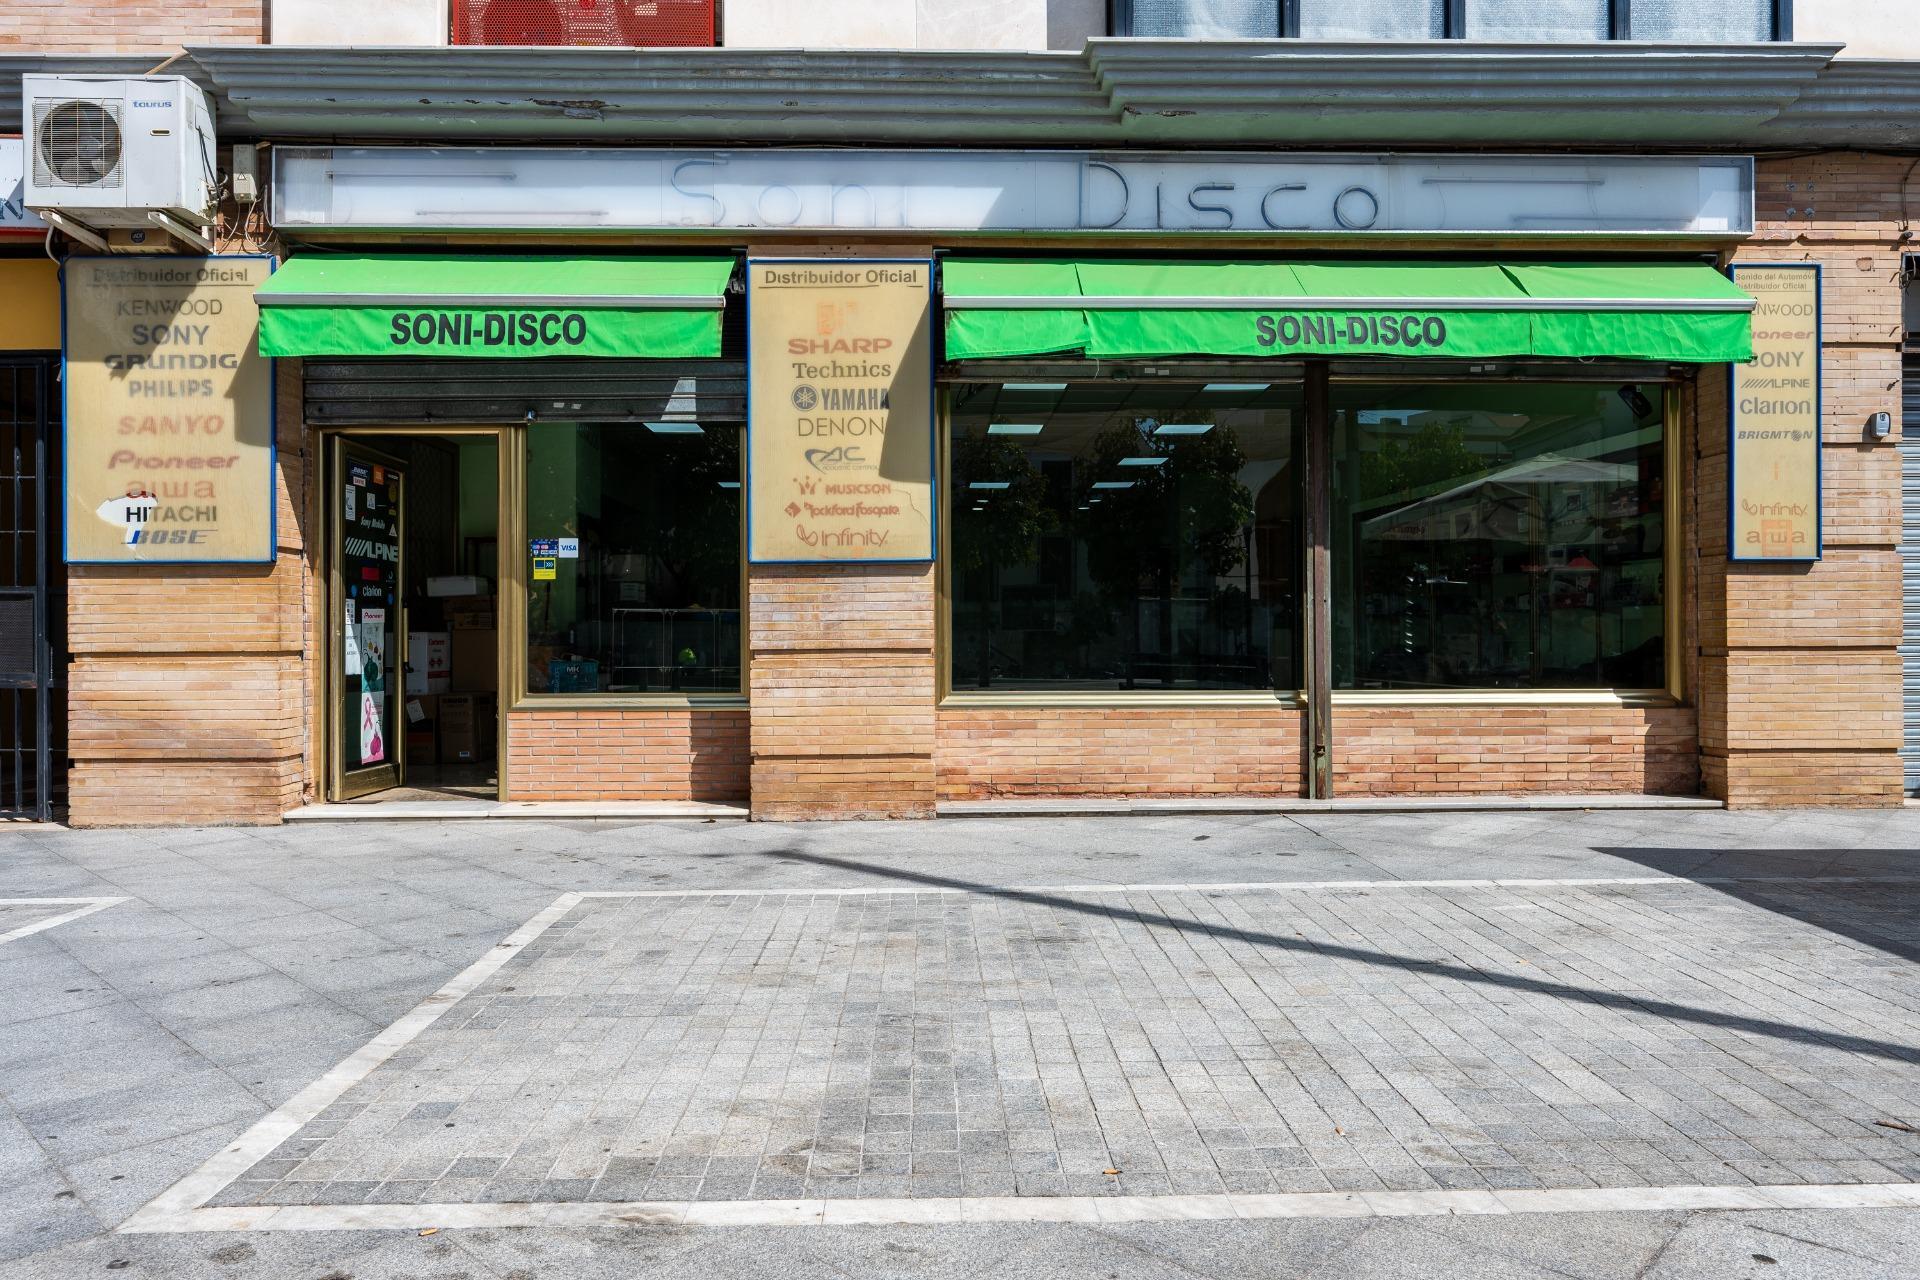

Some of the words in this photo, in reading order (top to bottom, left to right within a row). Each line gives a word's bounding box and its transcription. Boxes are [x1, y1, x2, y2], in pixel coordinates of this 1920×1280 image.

[132, 101, 172, 109] taurus
[93, 268, 190, 282] Distribuidor
[197, 268, 248, 282] Oficial
[765, 270, 861, 284] Distribuidor
[866, 270, 917, 283] Oficial
[1782, 282, 1807, 290] Oficial
[118, 299, 223, 316] KENWOOD
[1751, 304, 1813, 316] NWOOD
[132, 324, 210, 345] SONY
[390, 313, 587, 346] SONI-DISCO
[1256, 315, 1447, 347] SONI-DISCO
[1752, 331, 1815, 340] ioneer
[788, 338, 893, 355] SHARP
[792, 360, 891, 379] Technics
[129, 379, 213, 398] PHILIPS
[821, 388, 890, 410] YAMAHA
[1740, 397, 1811, 414] Clarion
[117, 415, 225, 436] SANYO
[798, 417, 884, 436] DENON
[108, 450, 240, 470] Pioneer
[126, 480, 216, 499] aiwa
[825, 484, 891, 495] MUSICSON
[126, 505, 217, 522] HITACHI
[121, 529, 217, 545] BOSE
[822, 528, 889, 547] Infinity
